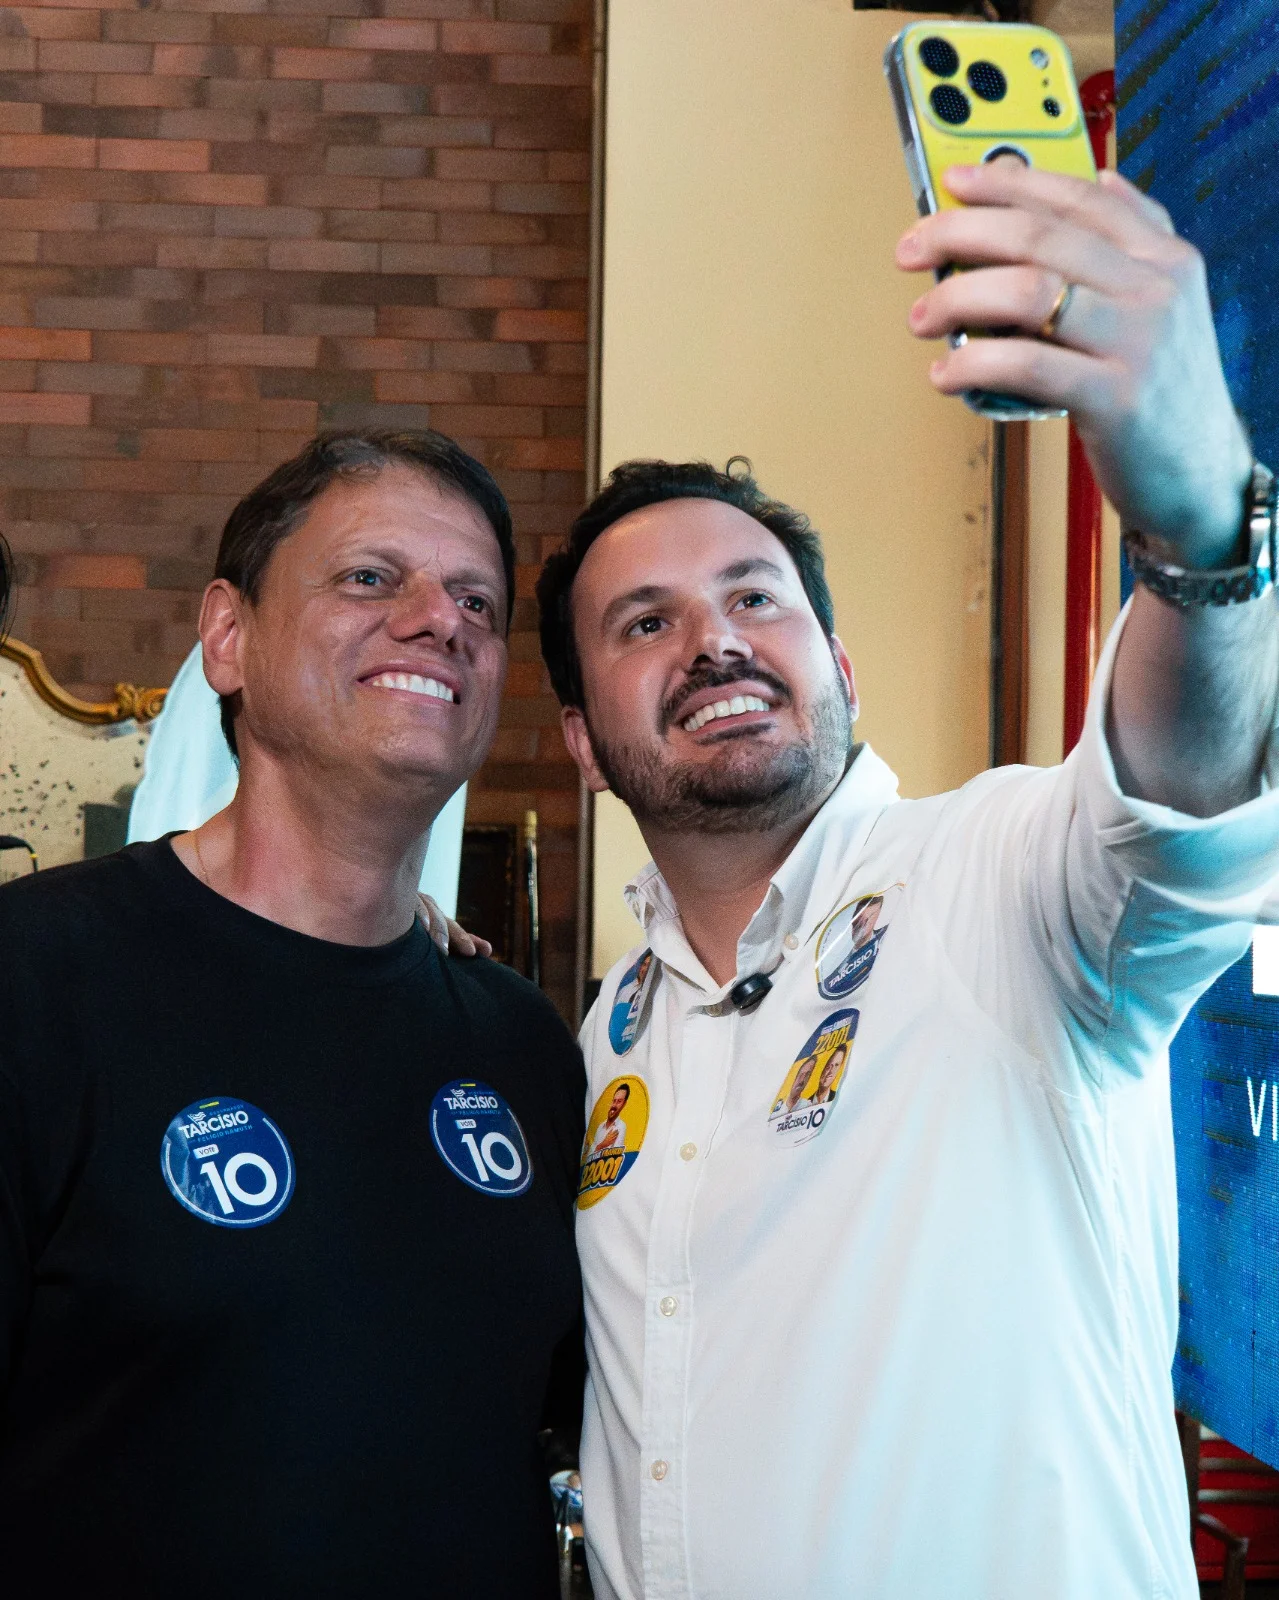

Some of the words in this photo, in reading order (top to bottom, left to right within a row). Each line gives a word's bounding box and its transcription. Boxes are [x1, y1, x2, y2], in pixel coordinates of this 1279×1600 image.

[807, 1108, 825, 1130] 10
[199, 1147, 216, 1156] VOTE
[461, 1132, 522, 1182] 10
[199, 1152, 278, 1215] 10
